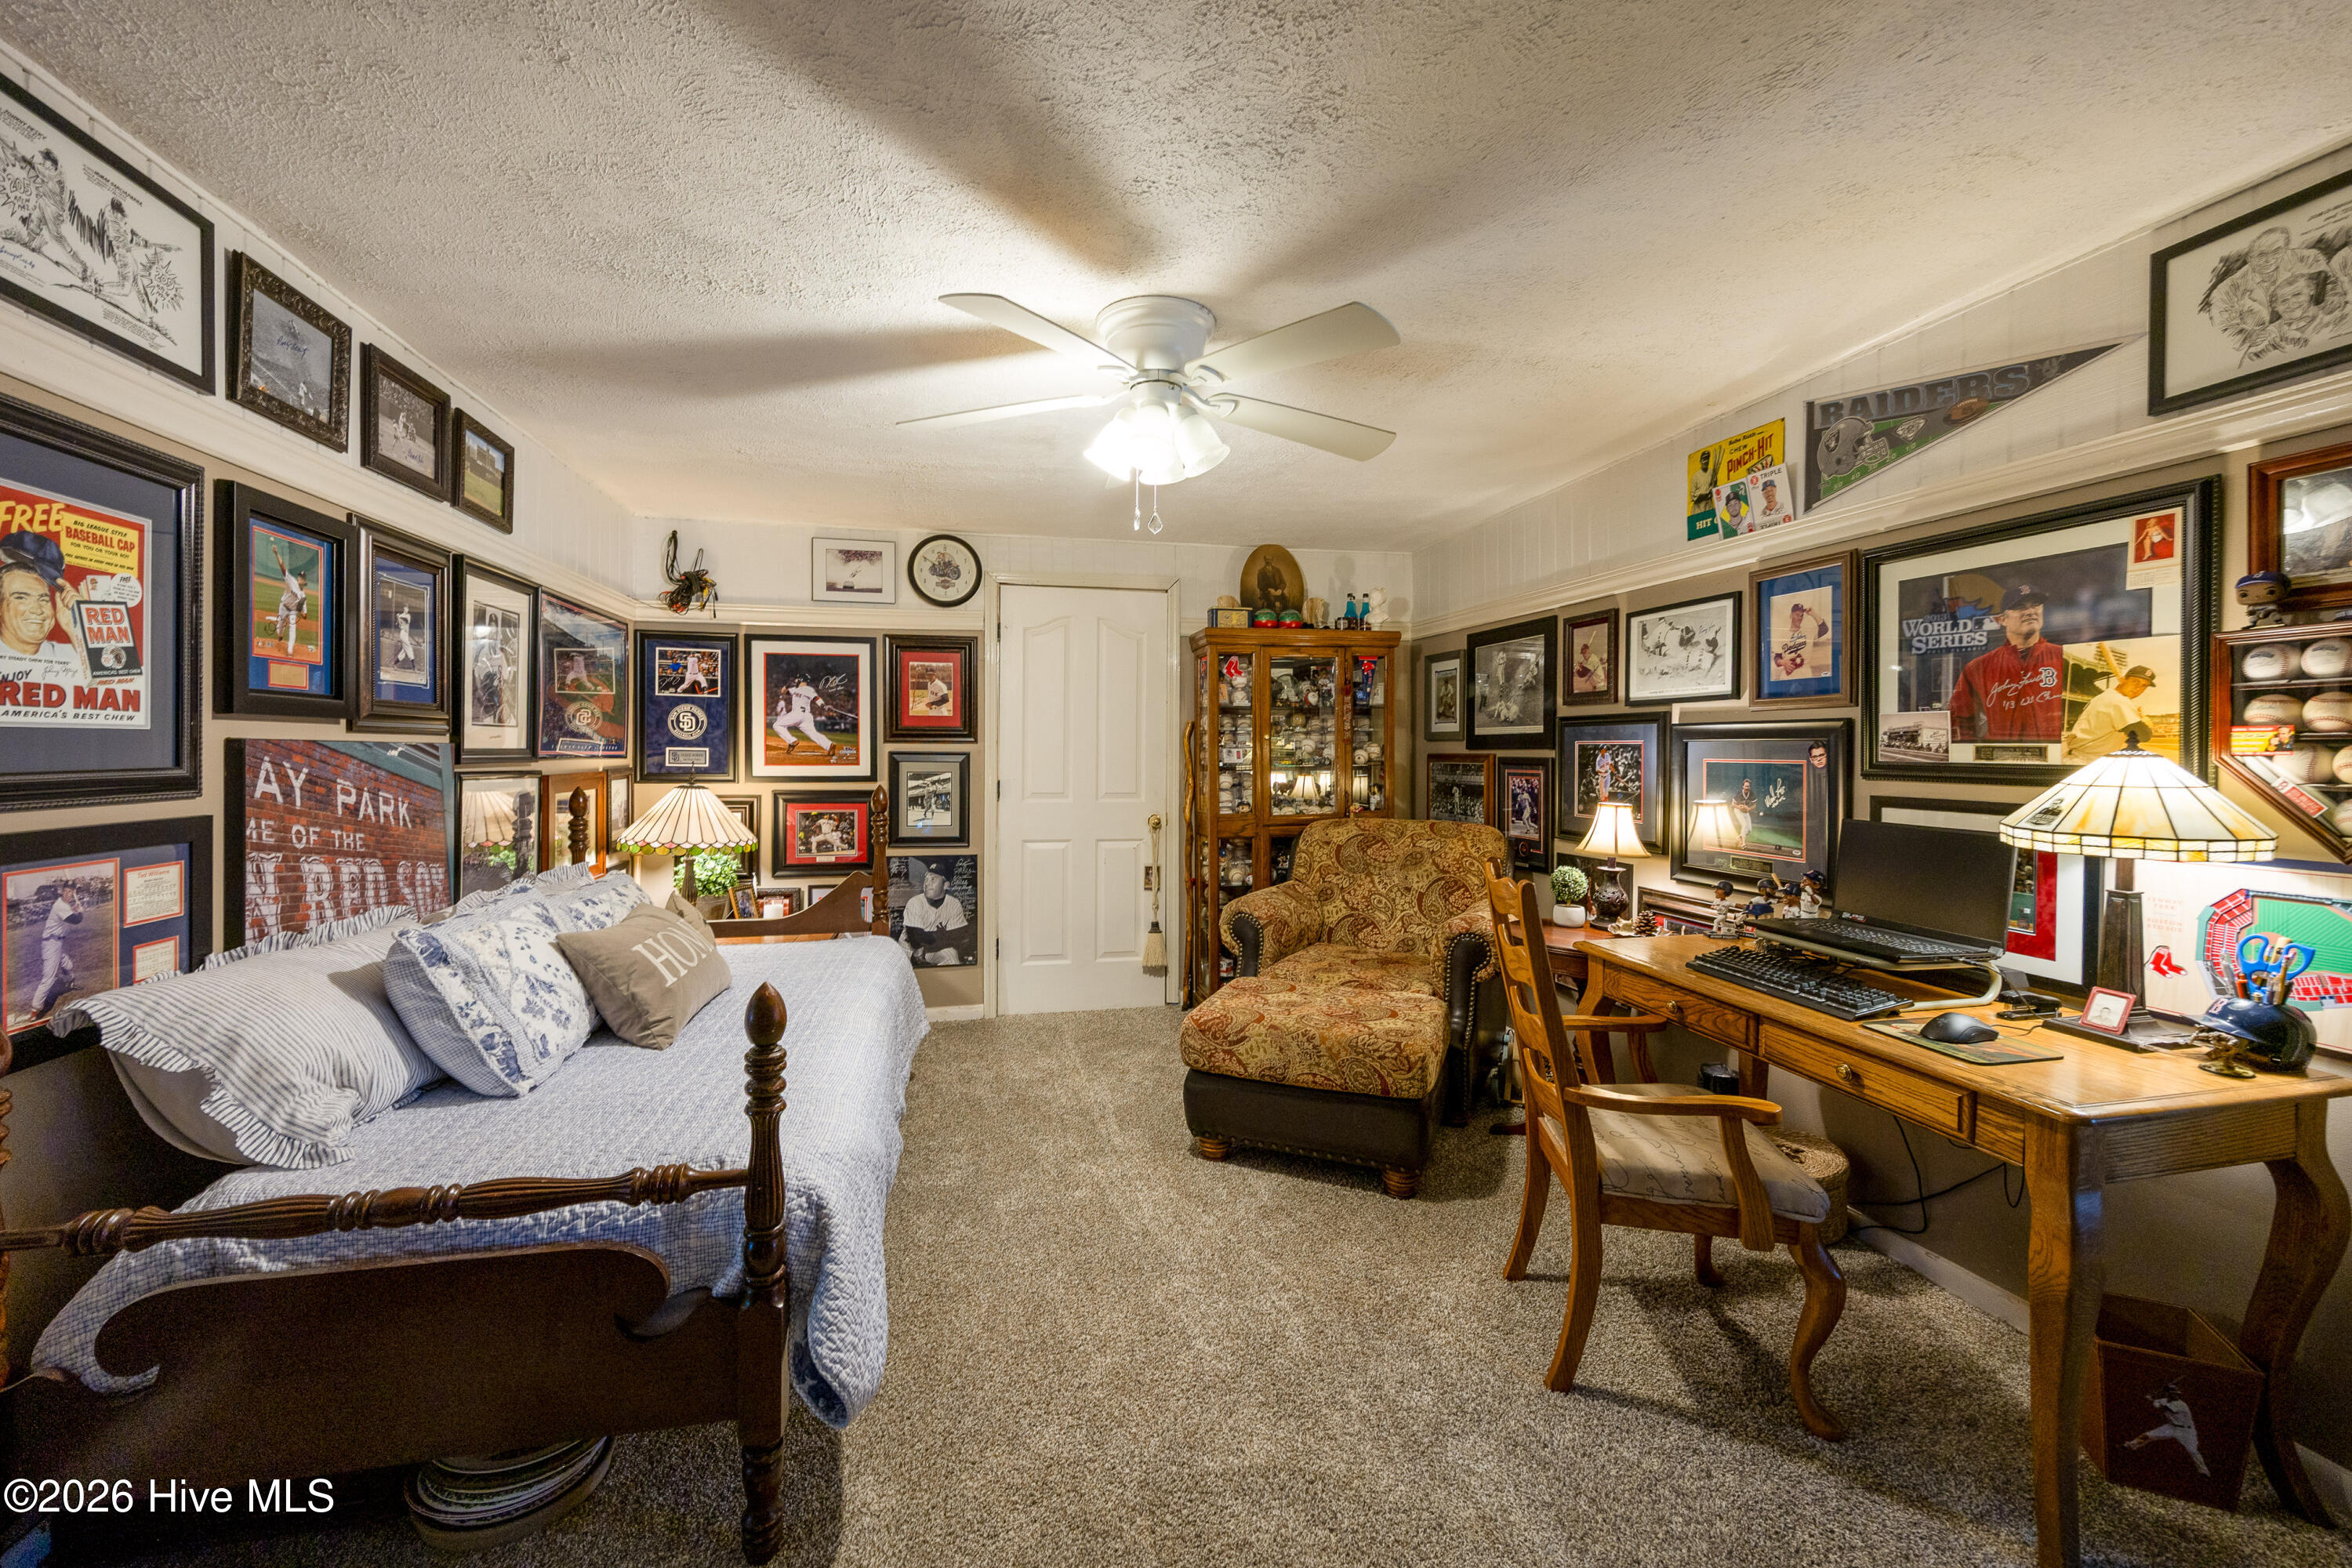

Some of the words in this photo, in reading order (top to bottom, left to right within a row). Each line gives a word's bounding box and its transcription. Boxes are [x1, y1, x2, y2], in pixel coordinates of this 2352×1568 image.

[1819, 365, 2030, 427] RAIDERS
[1726, 433, 1774, 481] PINCH-HIT
[1730, 443, 1748, 455] CHEW
[1760, 467, 1782, 480] TRIPLE
[0, 500, 65, 534] FREE
[1696, 518, 1712, 530] HIT
[65, 526, 114, 549] BASEBALL
[117, 539, 135, 553] CAP
[86, 524, 109, 534] LEAGUE
[85, 608, 125, 625] RED
[88, 626, 130, 644] MAN
[1902, 619, 1973, 637] WORLD
[1911, 631, 1987, 655] SERIES
[2039, 667, 2057, 688] B
[0, 681, 67, 709] RED
[73, 685, 140, 712] MAN
[1, 710, 67, 719] AMERICA'S
[253, 755, 309, 810] AY
[336, 777, 412, 829] PARK
[291, 824, 321, 849] OF
[330, 829, 365, 852] THE
[630, 918, 715, 988] HOM
